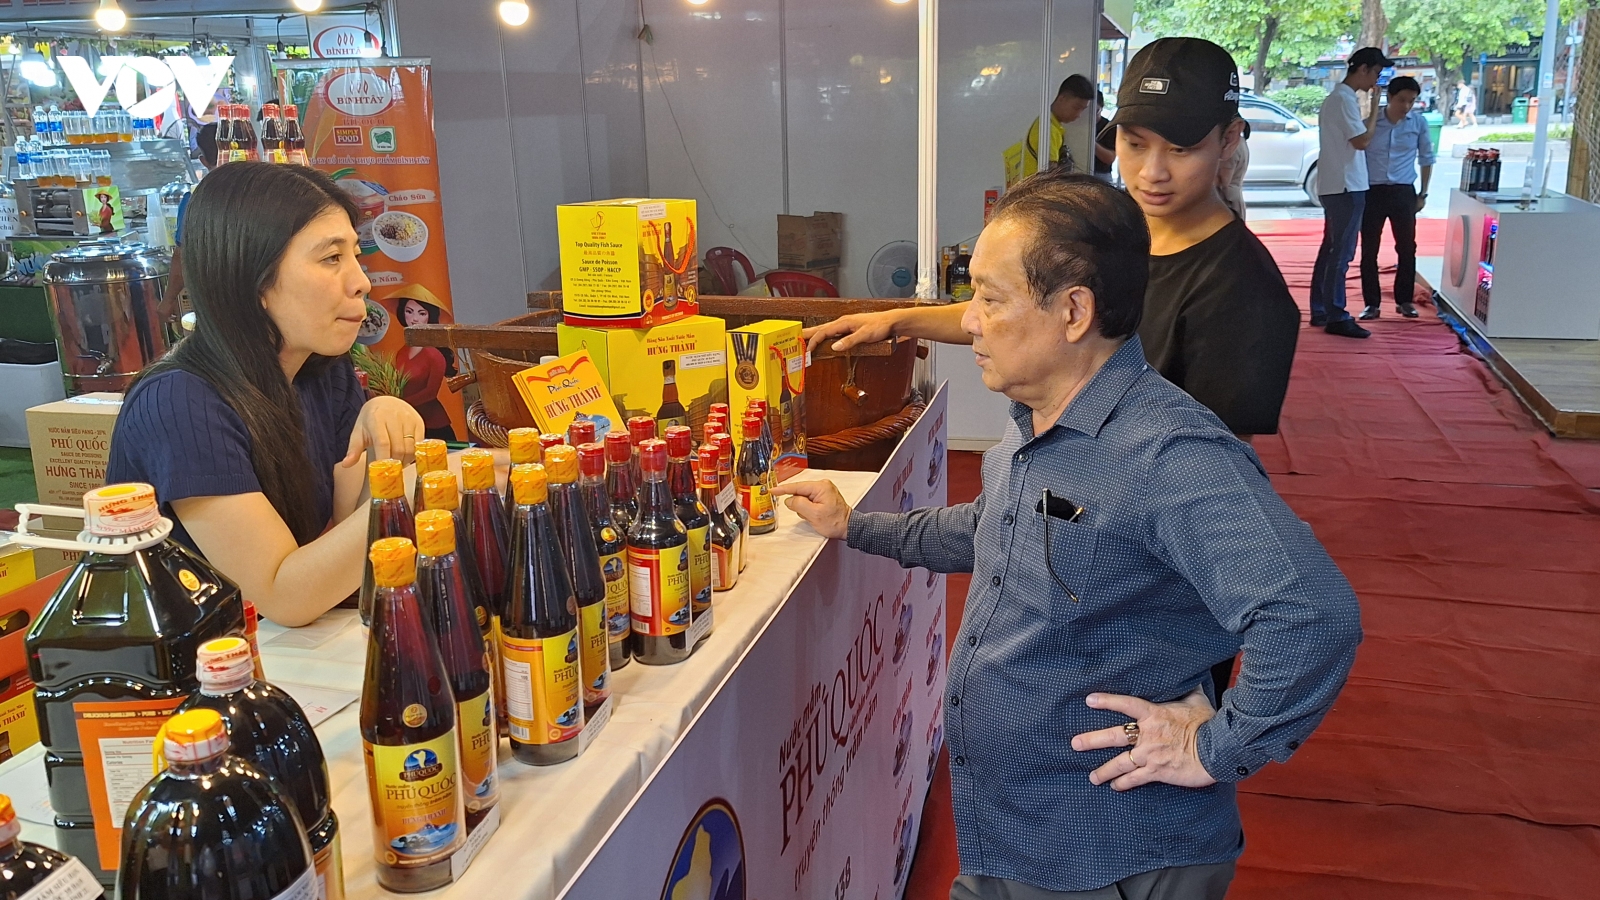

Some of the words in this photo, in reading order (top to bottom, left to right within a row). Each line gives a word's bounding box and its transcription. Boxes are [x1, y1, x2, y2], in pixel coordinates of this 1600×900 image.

[326, 46, 362, 56] BÌNHTÂ
[337, 135, 359, 143] FOOD
[388, 194, 408, 202] Cháo
[647, 345, 669, 356] HƯNG
[670, 341, 696, 353] THÀNH
[543, 399, 571, 419] HƯNG
[568, 387, 602, 409] THÀNH
[50, 436, 73, 449] PHÚ
[76, 436, 109, 452] QUỐC
[45, 465, 77, 478] HƯNG
[79, 465, 106, 479] THÀN
[69, 481, 87, 490] SINCE
[98, 498, 127, 513] HƯNG
[62, 551, 80, 561] PH
[3, 710, 26, 726] THÀNH
[779, 683, 829, 856] PHÚ
[830, 589, 885, 753] QUỐC
[778, 715, 802, 774] Nước
[802, 681, 822, 729] mắm
[386, 786, 417, 800] PHÚ
[418, 773, 457, 800] QUỐC
[794, 819, 821, 892] truyền
[822, 765, 845, 826] thống
[845, 733, 863, 773] trăm
[863, 692, 878, 734] năm
